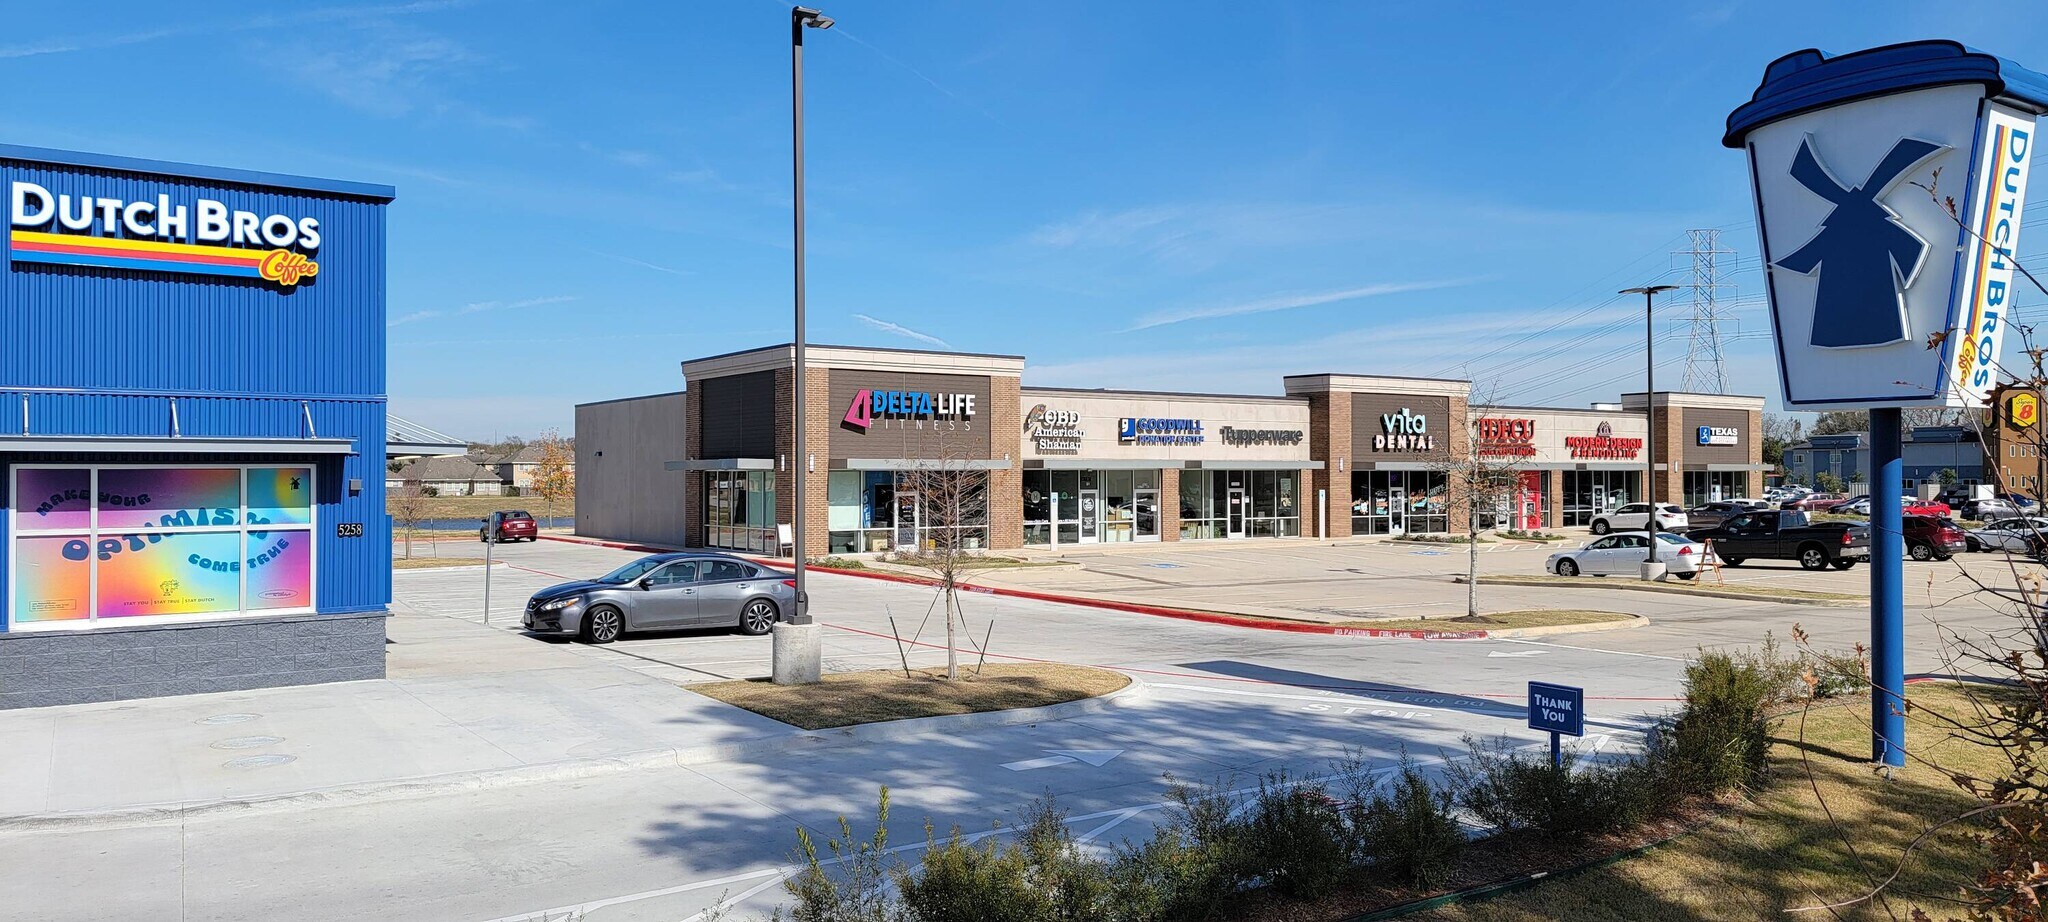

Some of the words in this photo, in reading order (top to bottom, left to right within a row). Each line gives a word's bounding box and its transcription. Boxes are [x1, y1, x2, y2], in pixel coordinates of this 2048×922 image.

[12, 181, 187, 239] DUTCH
[198, 199, 321, 249] BROS
[260, 249, 318, 284] Coffee
[1974, 279, 2006, 387] BROS
[1958, 335, 1976, 387] Coffee
[873, 391, 934, 414] DELTA
[938, 393, 976, 415] LIFE
[2020, 404, 2034, 419] 8
[869, 419, 971, 431] FITNESS
[1139, 417, 1204, 431] GOODWILL
[1383, 408, 1426, 434] vita
[1034, 427, 1085, 437] American
[1221, 426, 1304, 446] Tupperware
[1711, 427, 1738, 436] TEXAS
[1039, 438, 1082, 450] Shaman
[1375, 435, 1435, 450] DENTAL
[1567, 436, 1608, 449] MODERN
[1610, 437, 1643, 449] DESIGN
[1581, 449, 1638, 458] REMODELING
[36, 490, 91, 516] MAKE
[339, 524, 362, 536] 5258
[188, 553, 240, 572] COME
[247, 538, 289, 569] TRUE
[1334, 628, 1343, 636] NO
[1343, 629, 1371, 637] PARKING
[1378, 630, 1394, 638] FIRE
[1534, 693, 1573, 711] THANK
[1301, 703, 1433, 719] STOP
[1541, 707, 1565, 723] YOU
